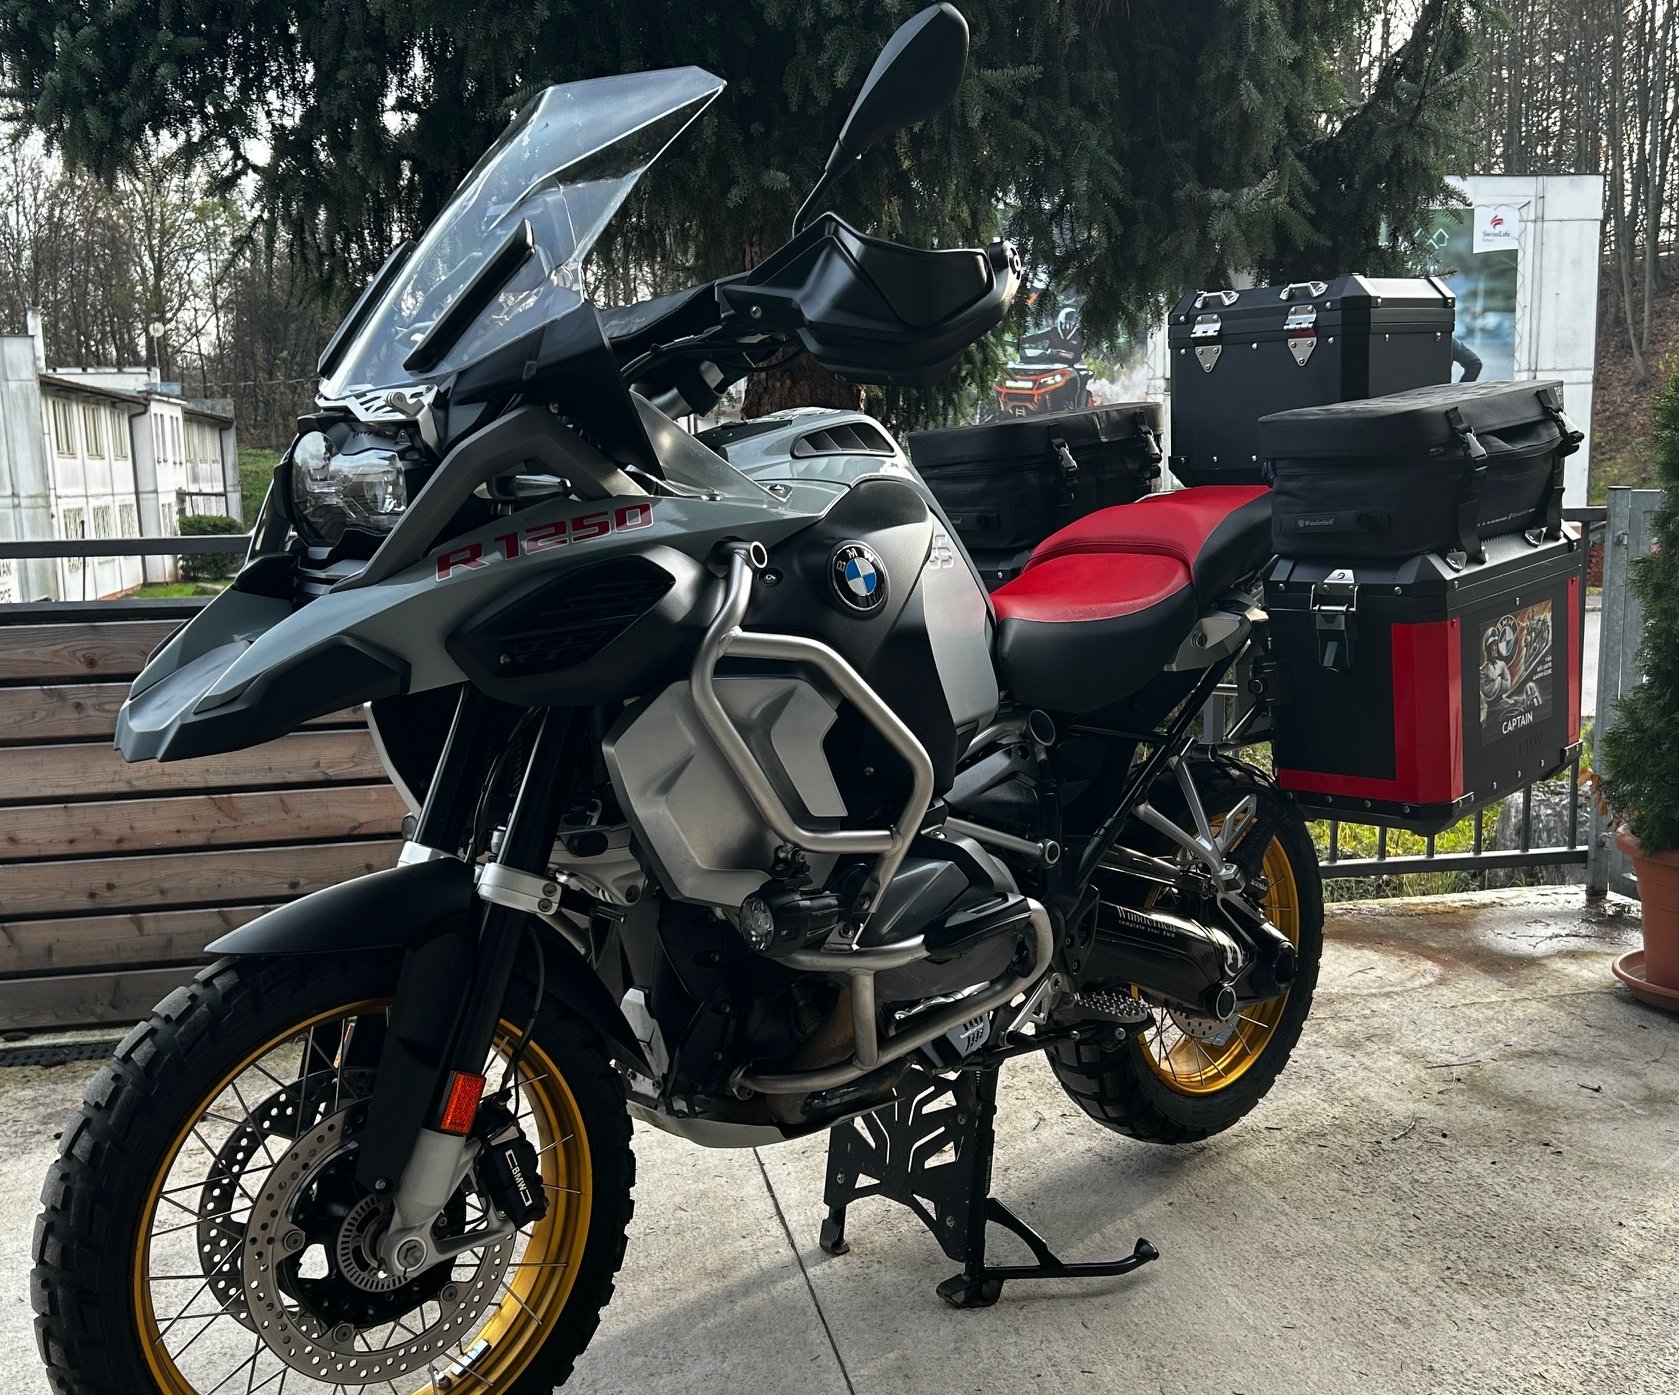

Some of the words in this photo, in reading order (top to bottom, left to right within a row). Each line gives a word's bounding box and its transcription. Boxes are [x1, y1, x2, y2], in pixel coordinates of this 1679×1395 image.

[435, 542, 490, 582] R
[494, 503, 654, 560] 1250
[836, 547, 875, 573] BMW
[1497, 617, 1514, 632] BMW
[1502, 711, 1533, 735] CAPTAIN
[1118, 919, 1146, 931] complete
[1162, 930, 1176, 938] BMW
[511, 1166, 528, 1191] BMW
